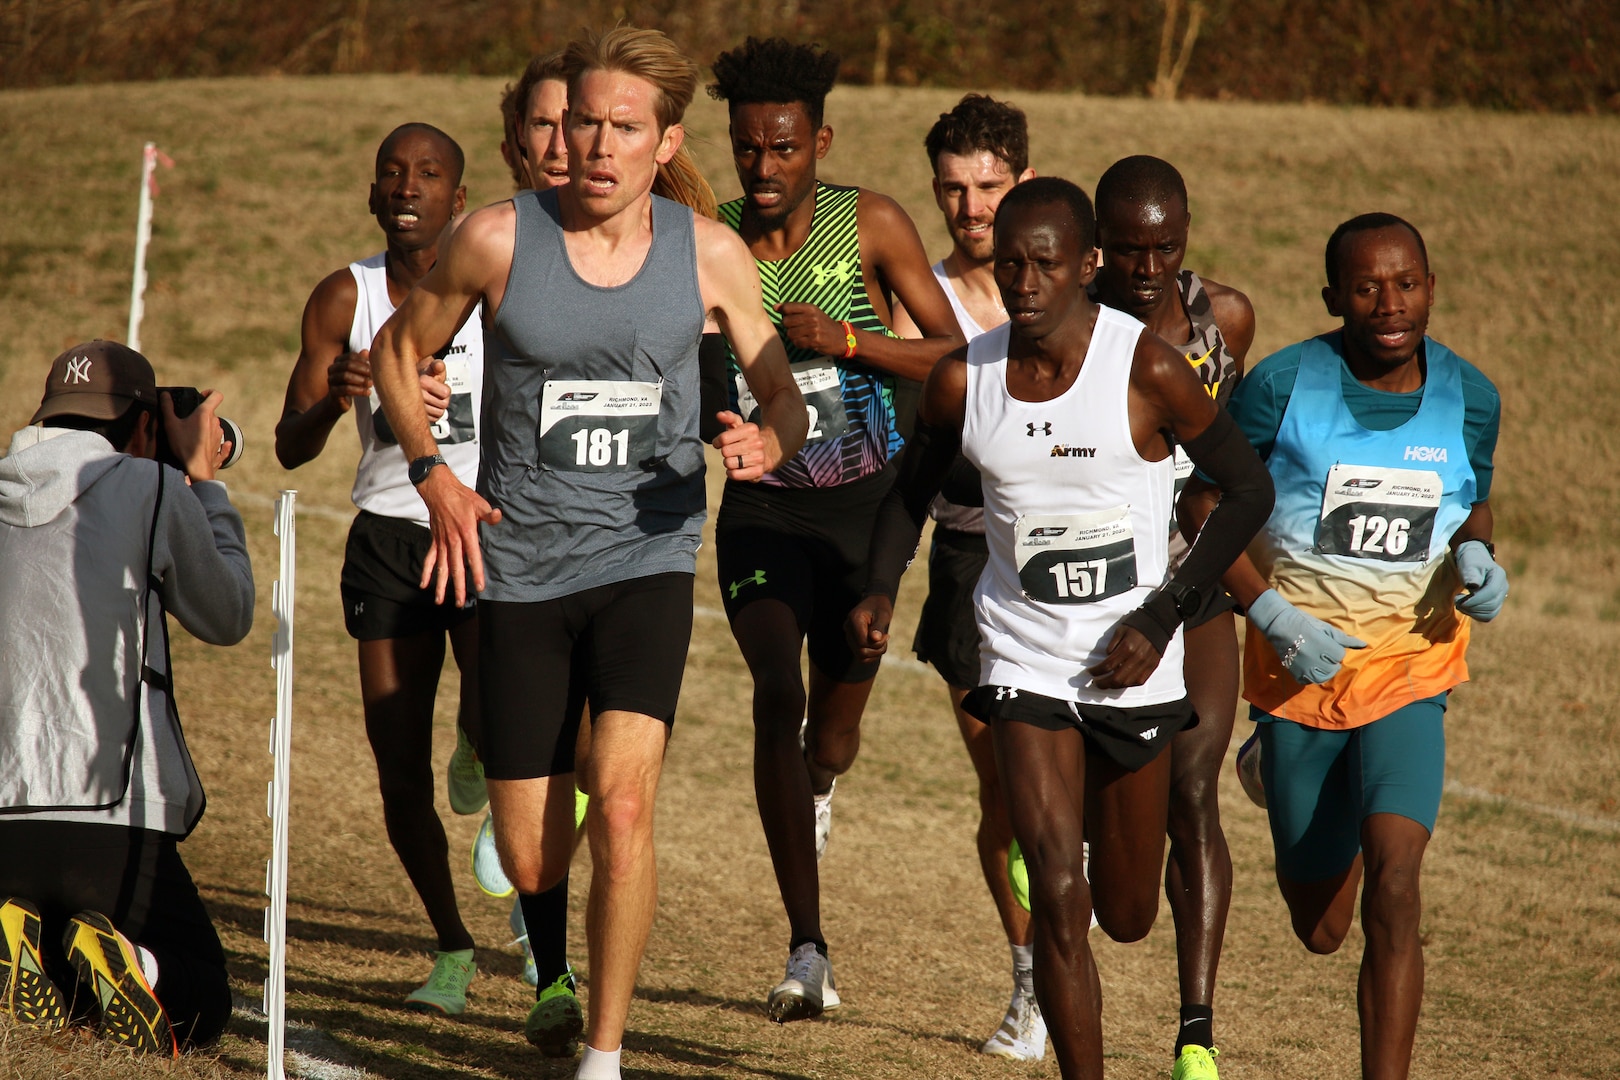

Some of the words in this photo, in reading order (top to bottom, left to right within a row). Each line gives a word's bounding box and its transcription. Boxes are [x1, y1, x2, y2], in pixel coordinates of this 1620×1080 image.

[448, 344, 467, 355] my
[63, 356, 92, 384] NY
[571, 428, 629, 467] 181
[1050, 444, 1097, 458] Army
[1403, 445, 1448, 463] HOKA
[1391, 485, 1422, 493] RICHMOND,
[1074, 533, 1102, 542] JANUARY
[1079, 525, 1112, 535] RICHMOND,
[1349, 514, 1411, 556] 126
[1048, 558, 1108, 598] 157
